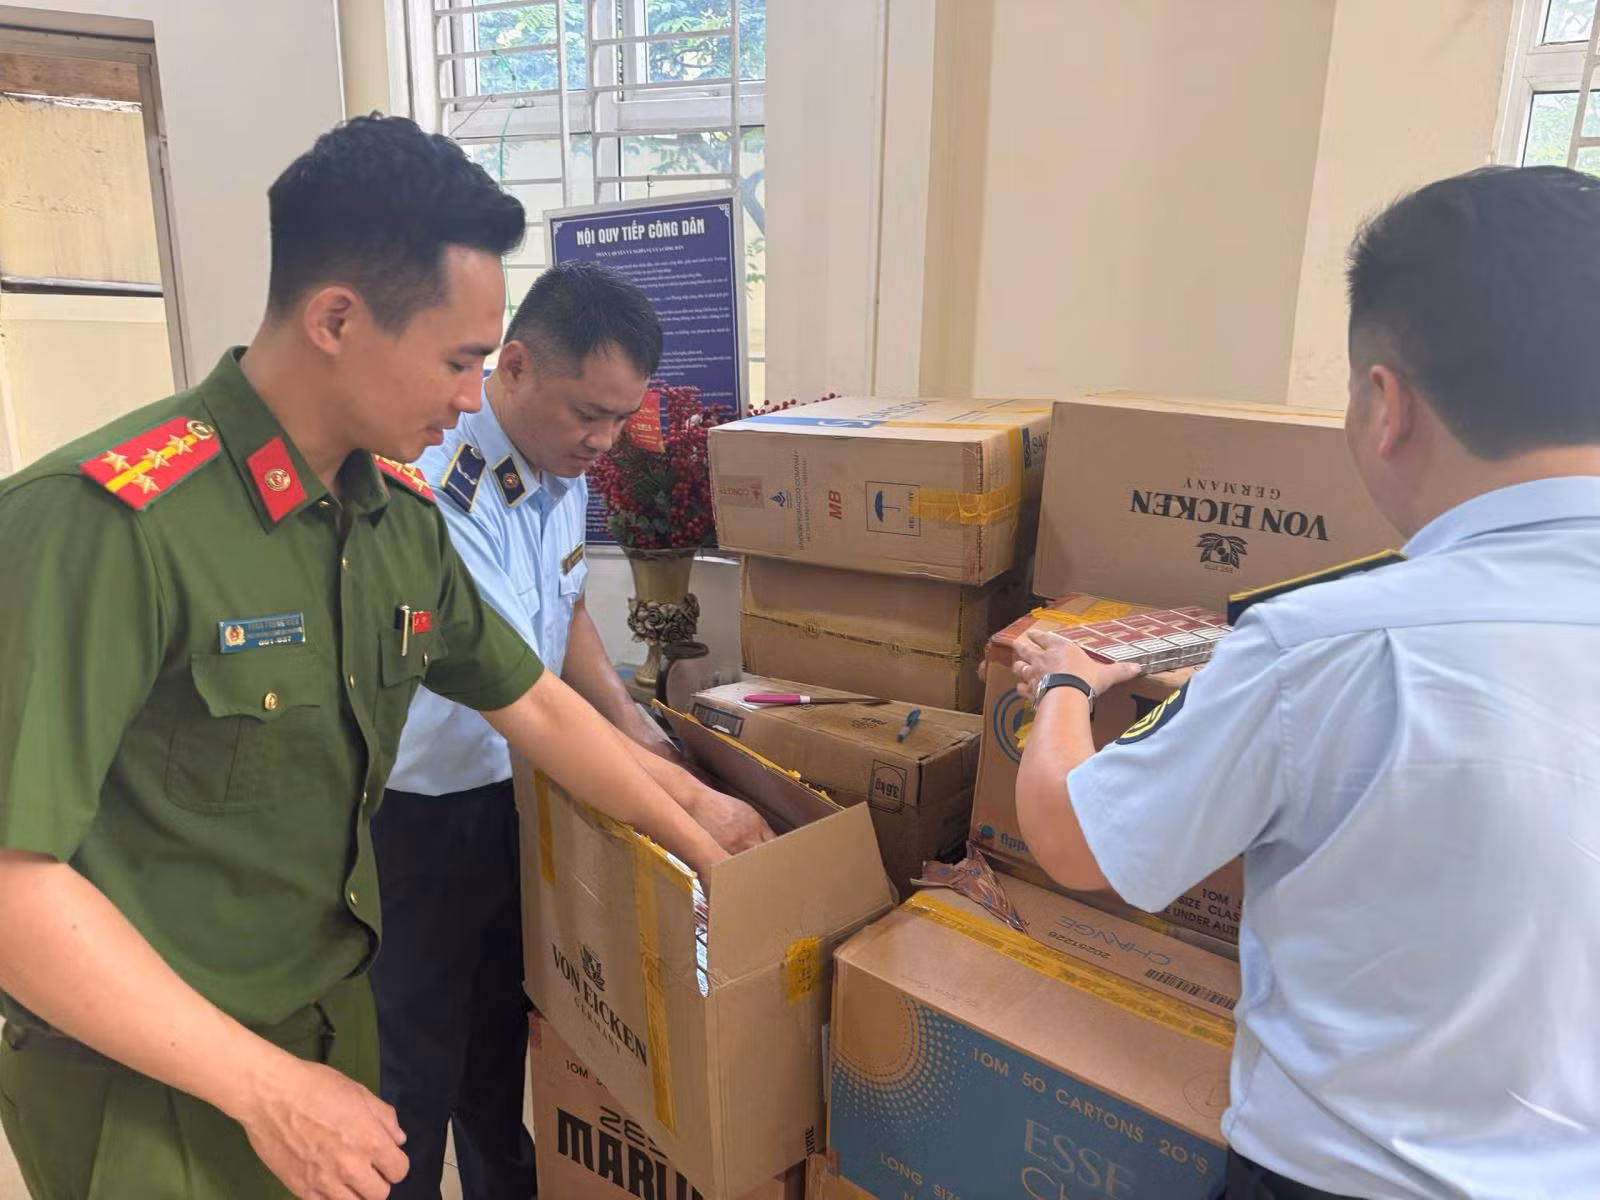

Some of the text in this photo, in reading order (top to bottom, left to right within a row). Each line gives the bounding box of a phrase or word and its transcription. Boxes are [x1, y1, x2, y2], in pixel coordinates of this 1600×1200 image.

[576, 216, 705, 248] NỘI QUY TIẾP CÔNG DÂN
[828, 489, 843, 520] MB
[1183, 477, 1281, 500] GERMANY
[1129, 489, 1329, 541] VON EICKEN
[1173, 907, 1212, 928] UNDER
[1177, 895, 1201, 910] SIZE
[1208, 905, 1241, 923] CLAS
[1055, 915, 1171, 966] CHANGE
[552, 943, 647, 1067] VON EICKEN
[1023, 1071, 1046, 1094] 50
[1055, 1089, 1144, 1144] CARTONS
[1159, 1138, 1209, 1175] 20'S
[880, 1151, 923, 1186] LONG
[1024, 1119, 1137, 1200] ESSE
